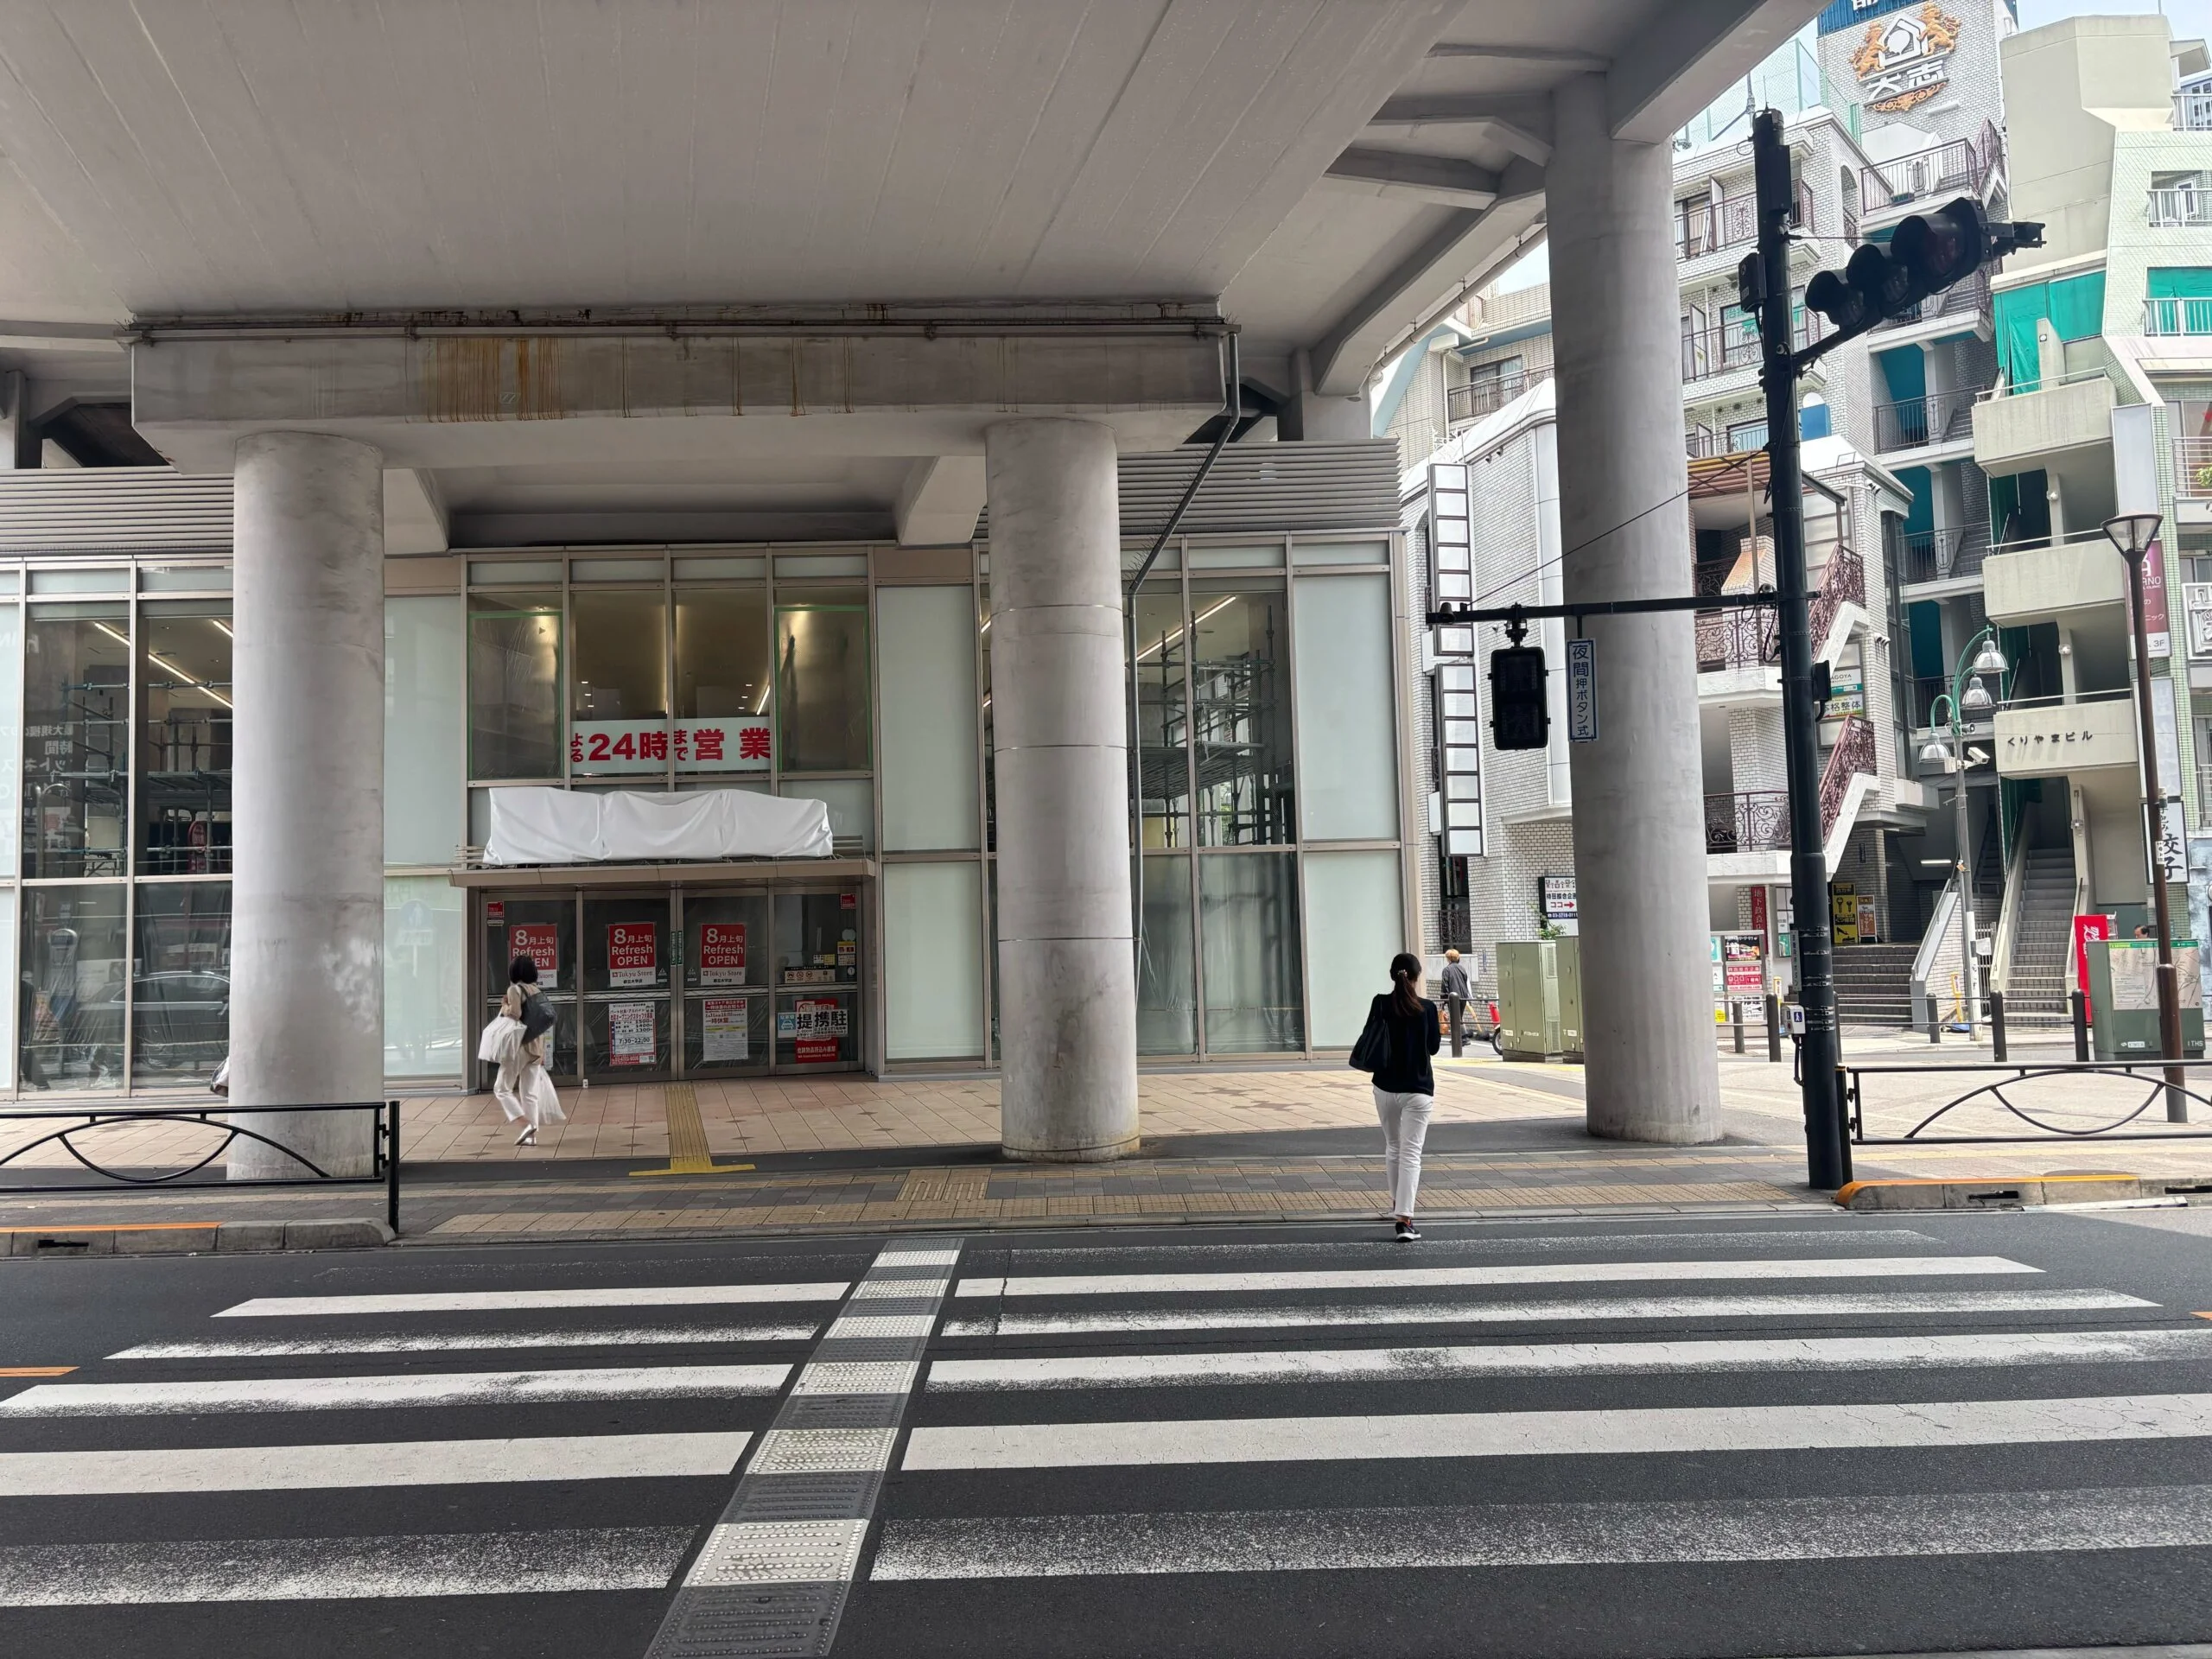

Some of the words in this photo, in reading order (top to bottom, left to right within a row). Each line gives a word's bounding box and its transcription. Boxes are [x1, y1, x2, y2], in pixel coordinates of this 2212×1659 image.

[2153, 639, 2164, 648] 3F
[1573, 645, 1589, 735] 夜間押ボタン式
[2007, 730, 2093, 747] くりやまビル
[515, 930, 554, 945] 8月上旬
[614, 928, 652, 944] 8月上旬
[707, 928, 743, 944] 8月上旬
[512, 946, 555, 957] Refresh
[612, 944, 653, 956] Refresh
[703, 944, 744, 955] Refresh
[534, 957, 550, 967] EN
[617, 956, 648, 966] OPEN
[709, 956, 738, 965] OPEN
